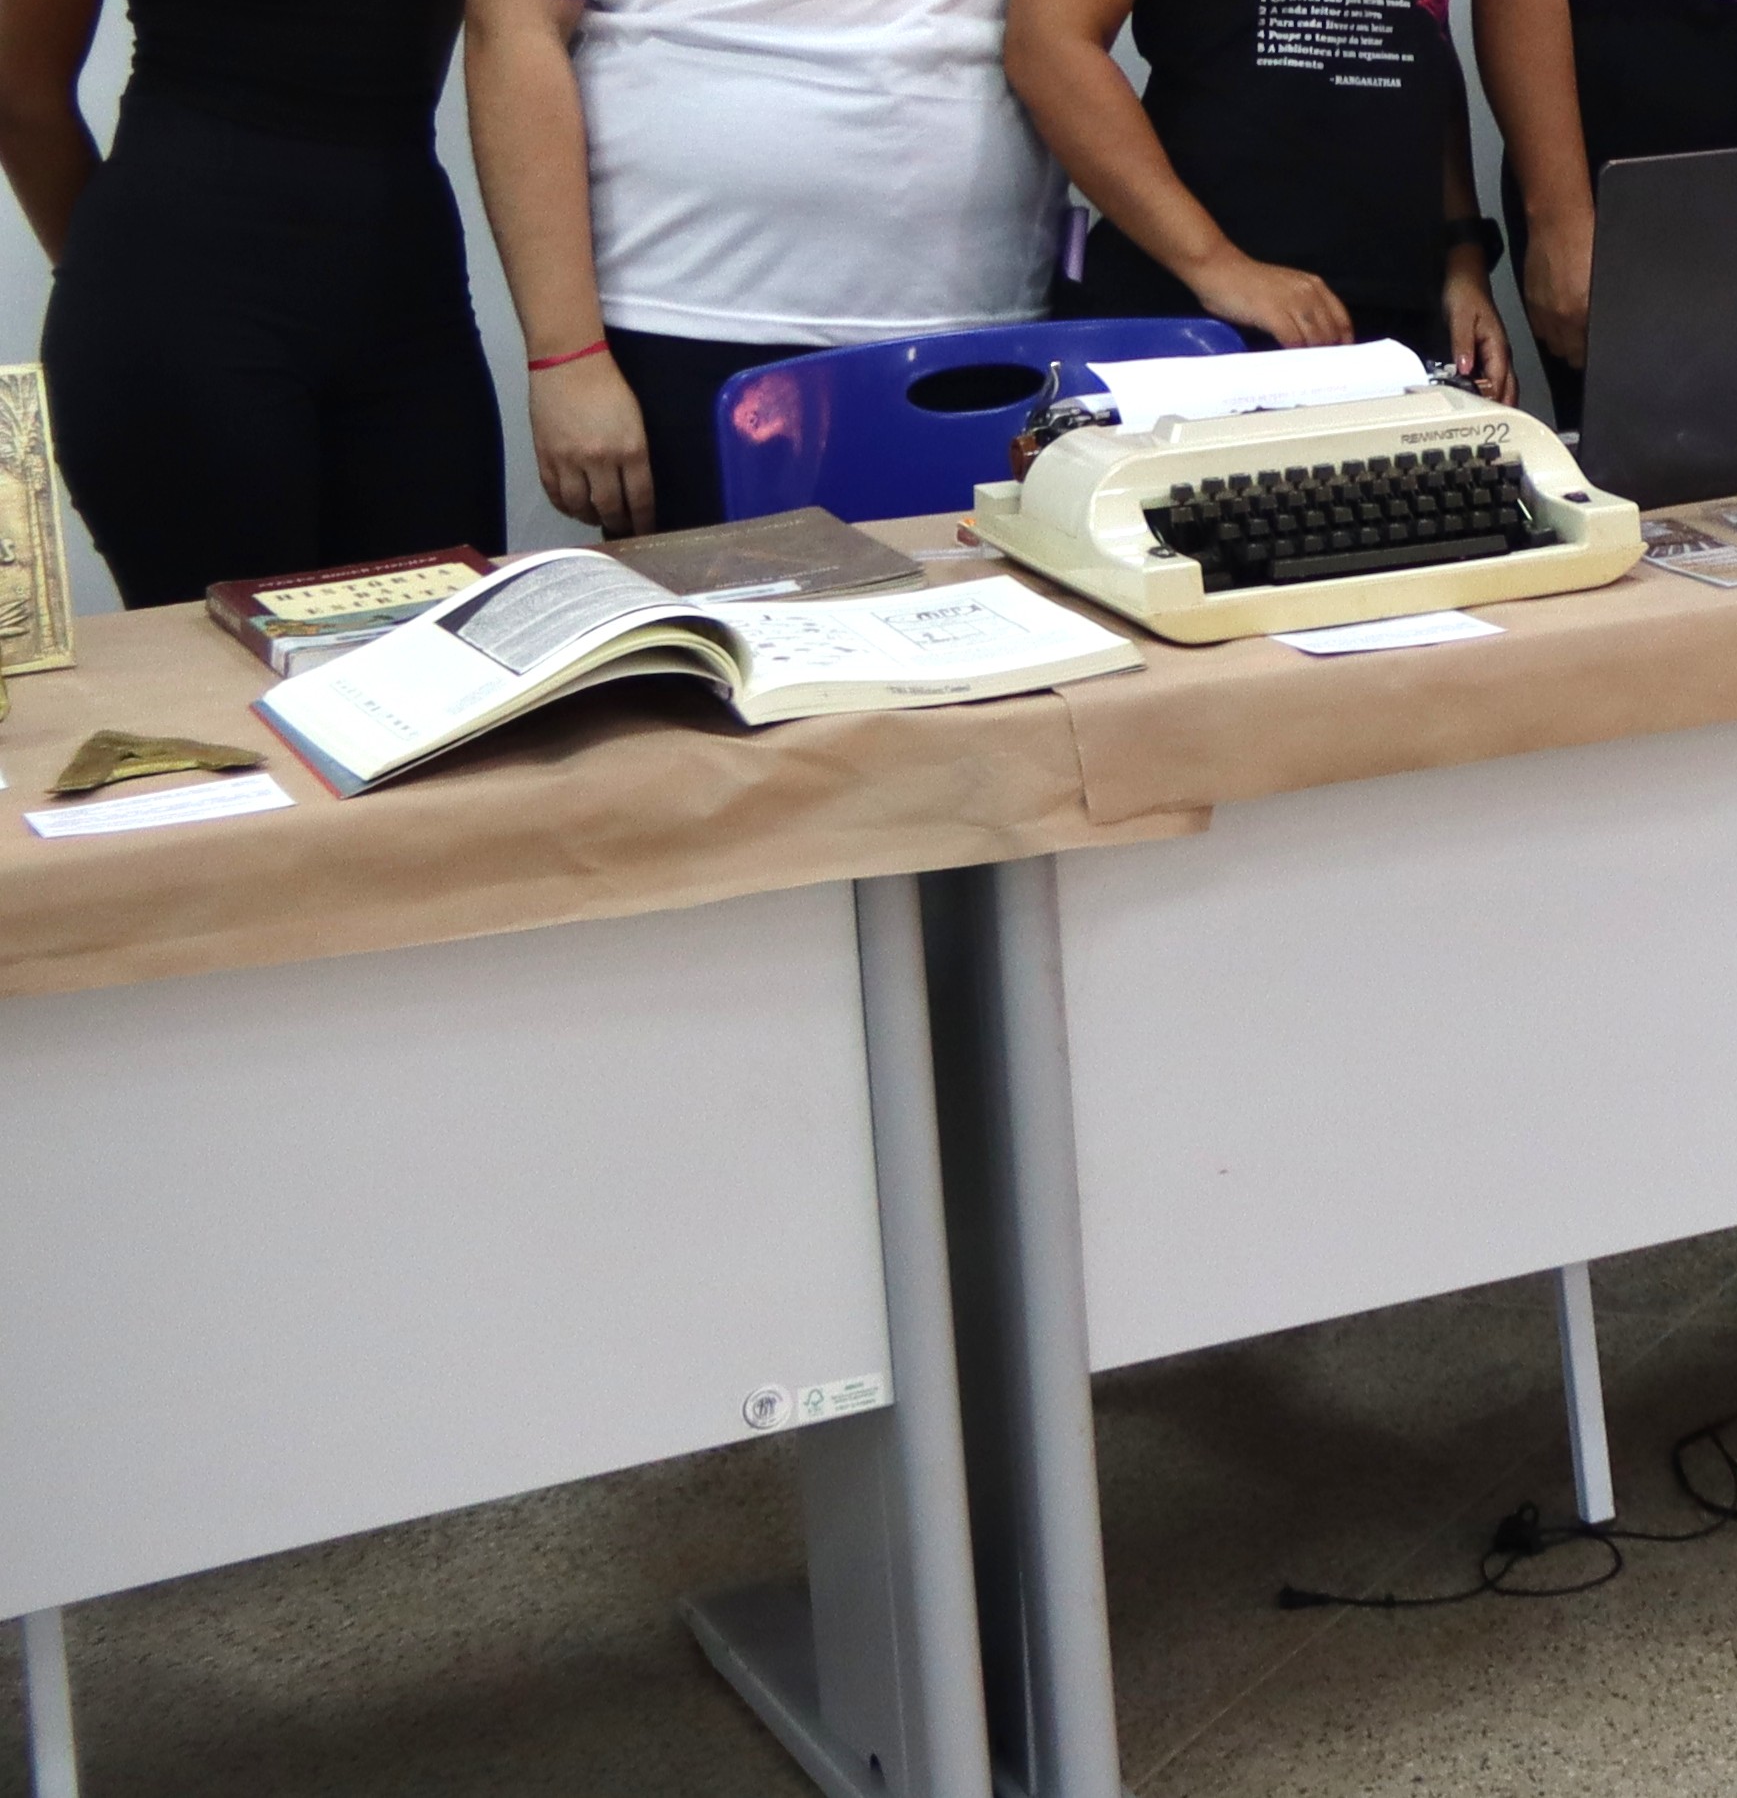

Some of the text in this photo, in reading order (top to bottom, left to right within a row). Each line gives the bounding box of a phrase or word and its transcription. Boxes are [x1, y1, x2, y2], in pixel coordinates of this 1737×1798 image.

[1281, 5, 1307, 15] cada
[1310, 6, 1340, 17] leitor
[1269, 18, 1294, 28] Para
[1297, 19, 1322, 29] cada
[1268, 30, 1301, 42] Poupe
[1268, 43, 1276, 53] A
[1278, 43, 1332, 57] biblioteca
[1256, 56, 1325, 70] crescimento
[1401, 423, 1511, 445] REMINGTON 22
